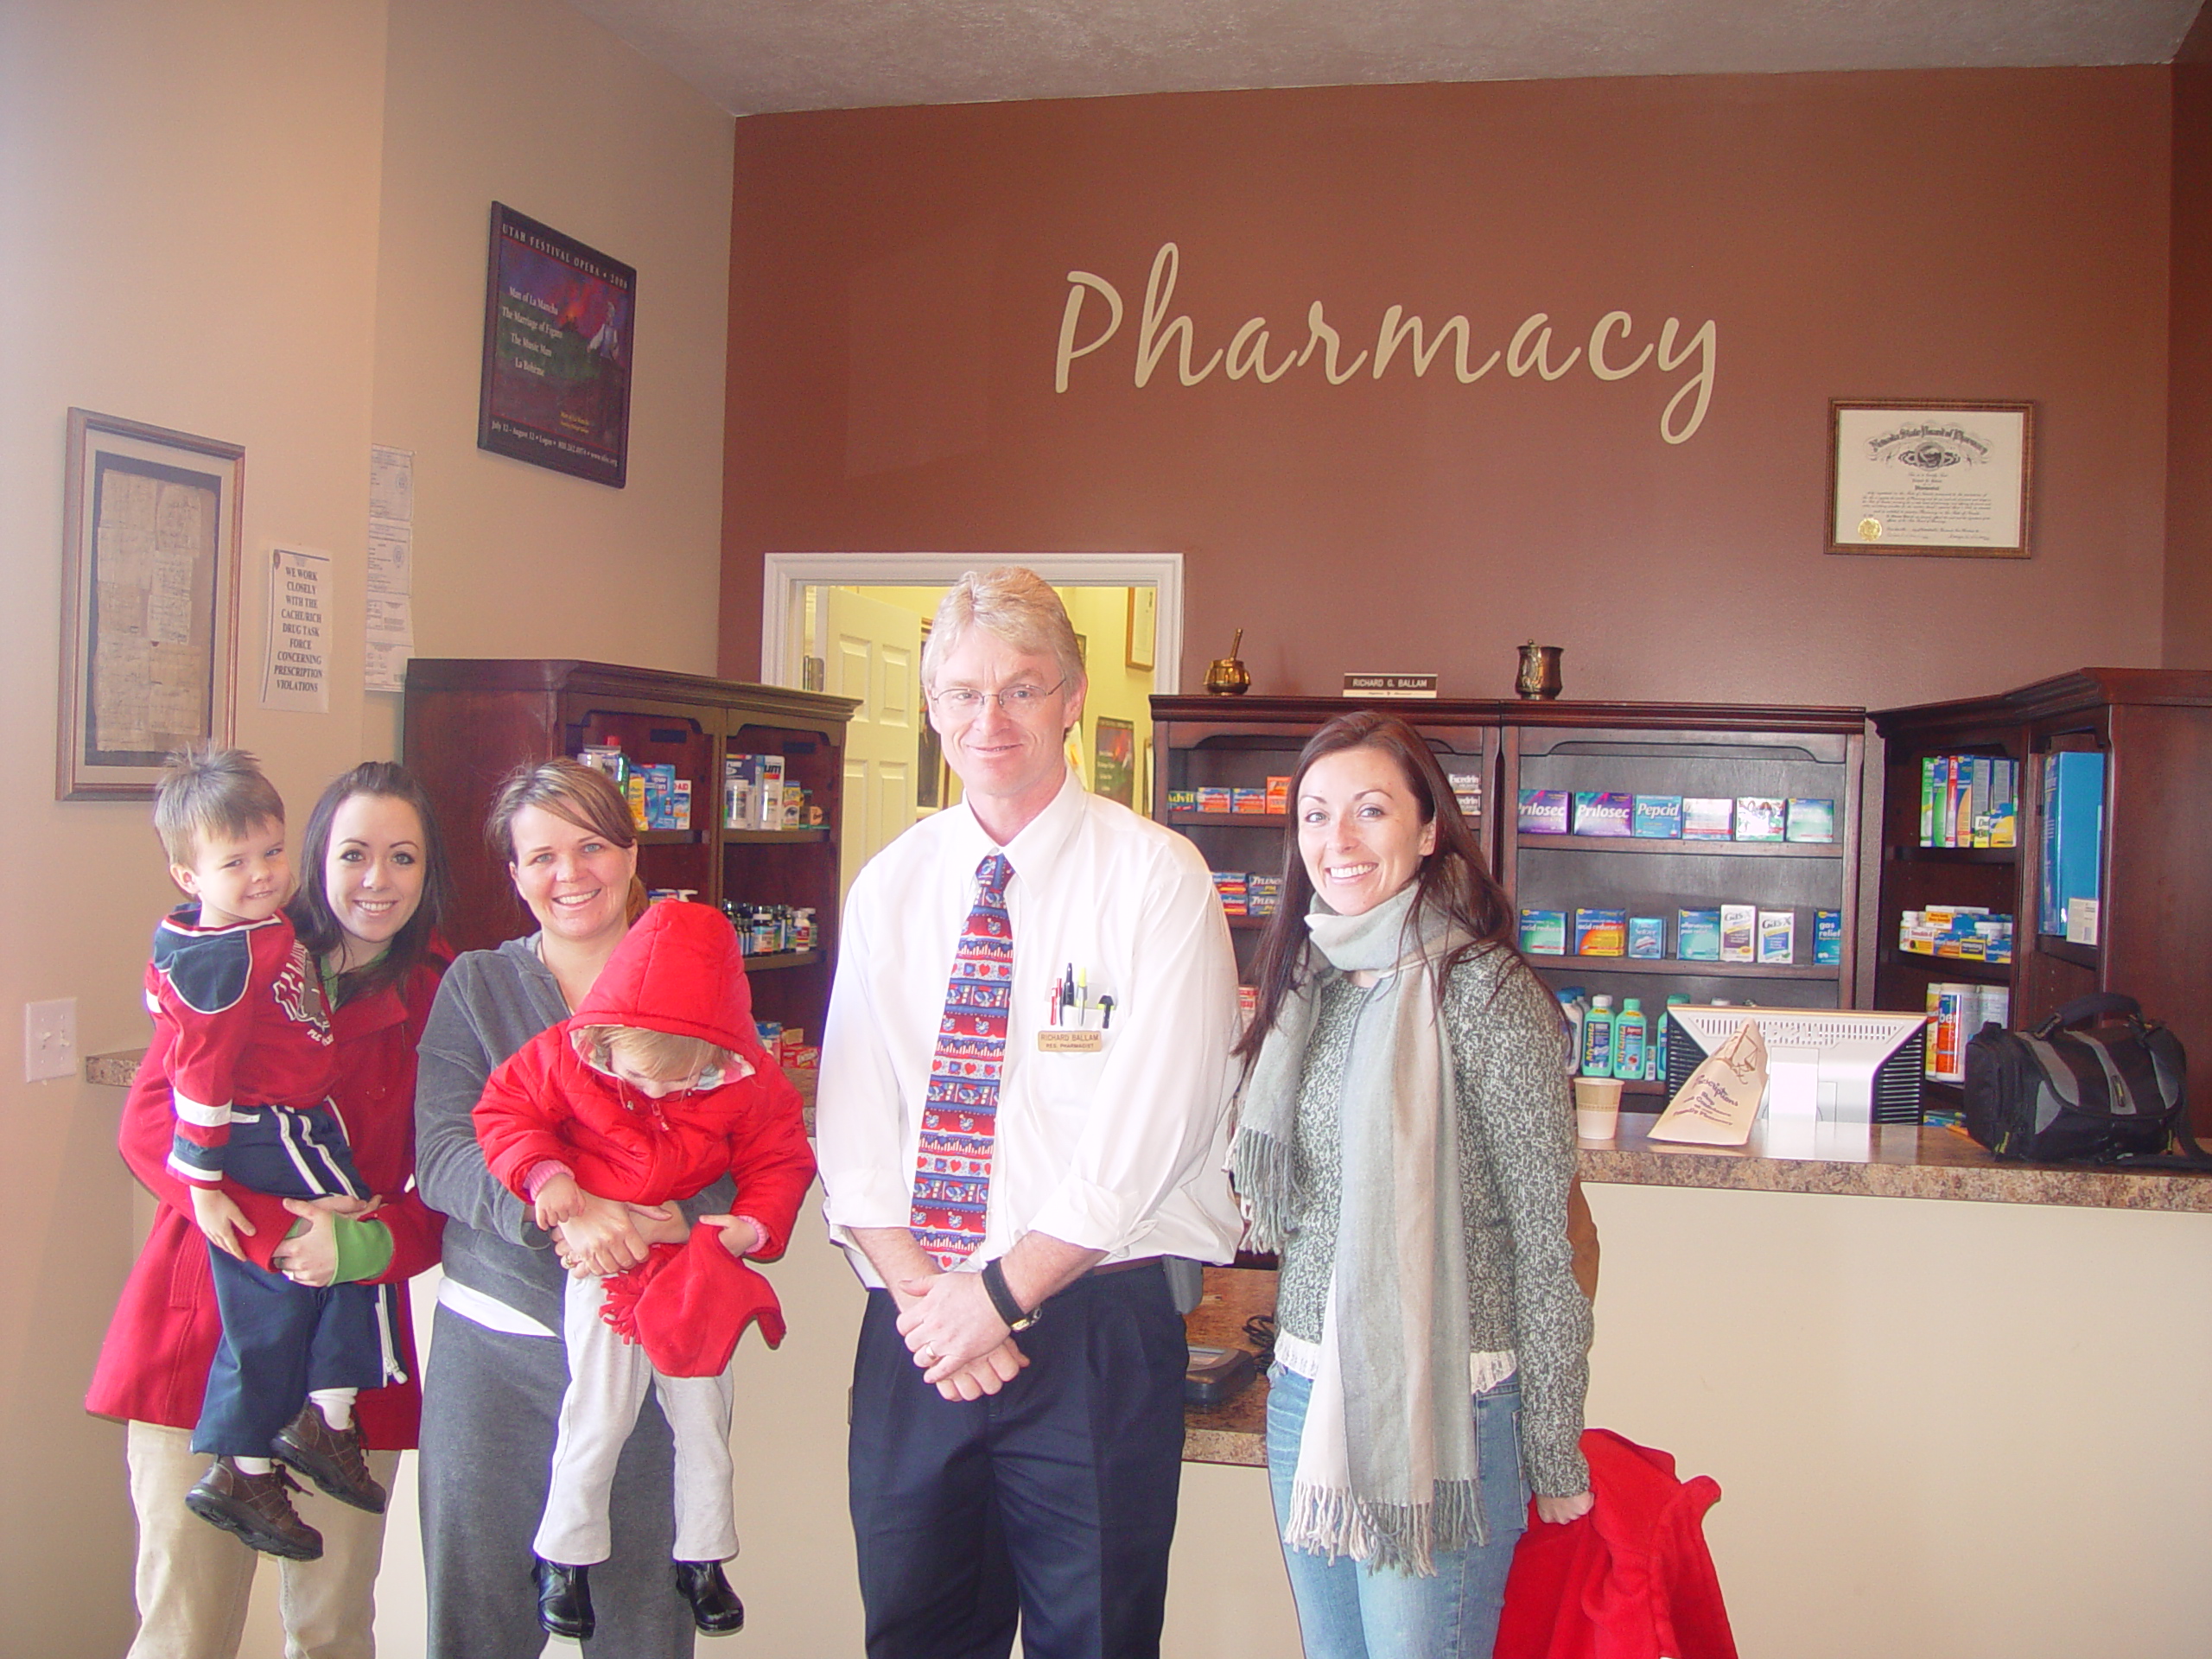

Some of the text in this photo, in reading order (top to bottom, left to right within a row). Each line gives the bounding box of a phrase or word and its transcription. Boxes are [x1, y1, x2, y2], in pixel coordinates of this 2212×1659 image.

[502, 224, 526, 242] UTAH
[531, 237, 570, 263] FESTIVAL
[574, 257, 600, 276] OPERA
[502, 306, 513, 319] The
[511, 333, 521, 346] The
[1055, 242, 1717, 445] Pharmacy
[515, 357, 523, 369] La
[285, 567, 318, 582] WE WORK
[287, 581, 315, 594] CLOSELY
[286, 595, 318, 608] WITH THE
[283, 623, 320, 638] DRUG TASK
[289, 639, 312, 650] FORCE
[277, 651, 322, 665] CONCERNING
[274, 664, 323, 678] PRESCRIPTION
[276, 679, 319, 692] VIOLATIONS
[1352, 678, 1383, 688] RICHARD
[1397, 679, 1427, 688] BALLAM
[1167, 793, 1194, 803] Advil
[1578, 804, 1630, 819] Prilosec
[1637, 803, 1680, 820] Pepcid
[1819, 922, 1835, 931] gas
